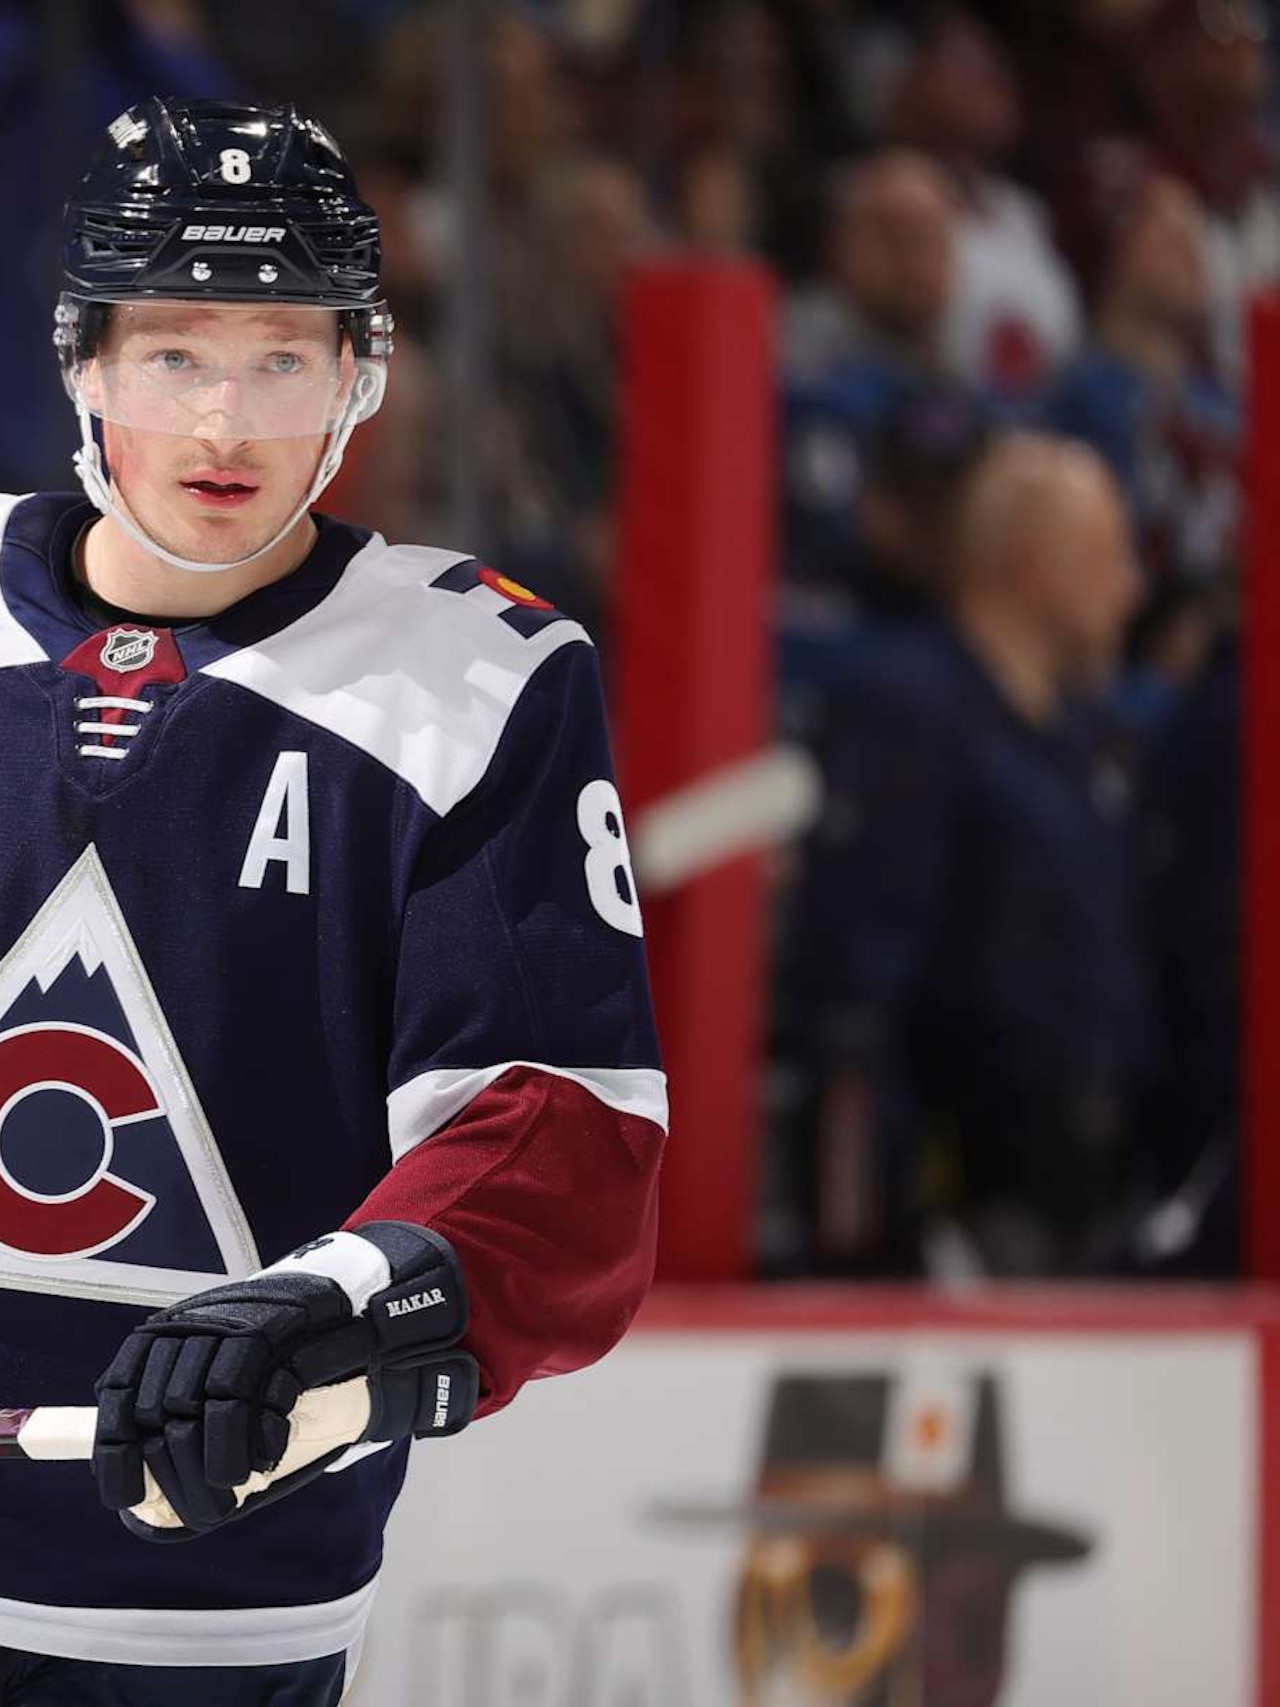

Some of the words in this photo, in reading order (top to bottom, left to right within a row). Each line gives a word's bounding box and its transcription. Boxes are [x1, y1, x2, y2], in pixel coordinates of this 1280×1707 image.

[220, 148, 252, 184] 8
[113, 641, 148, 661] NHL
[238, 751, 310, 894] A
[577, 779, 644, 937] 8
[385, 1287, 447, 1318] MAKAR
